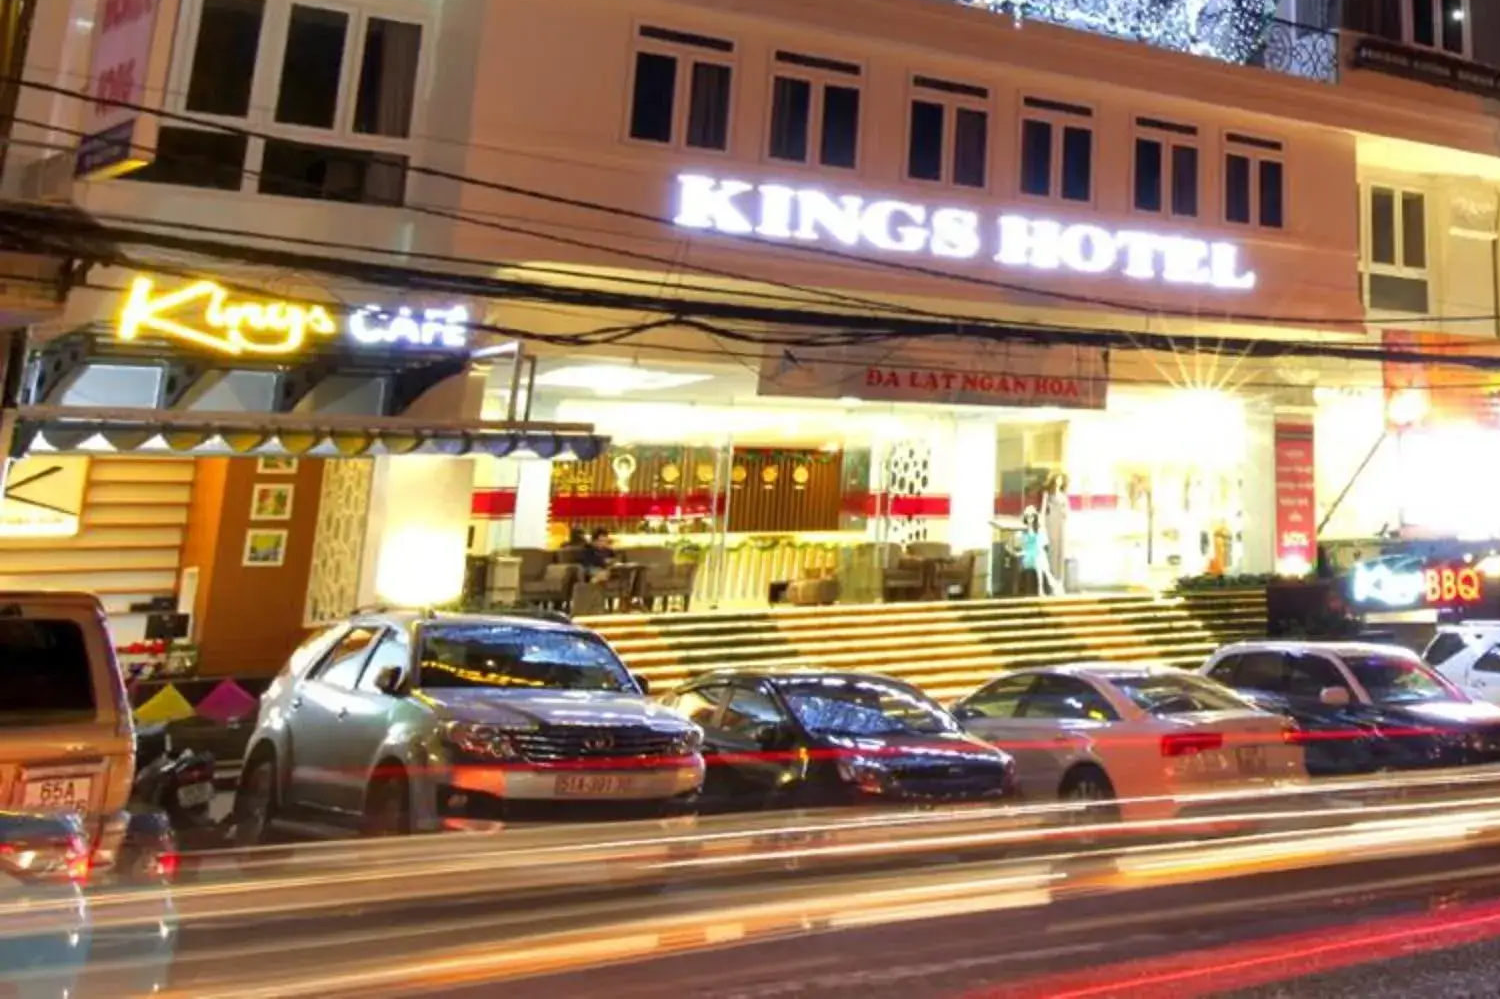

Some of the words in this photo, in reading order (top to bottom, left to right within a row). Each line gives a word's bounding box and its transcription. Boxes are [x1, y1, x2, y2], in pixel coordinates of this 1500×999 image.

[675, 174, 980, 258] KINGS
[994, 214, 1257, 290] HOTEL
[117, 276, 337, 355] Kings
[1425, 568, 1481, 602] BBQ
[40, 782, 76, 802] 65A
